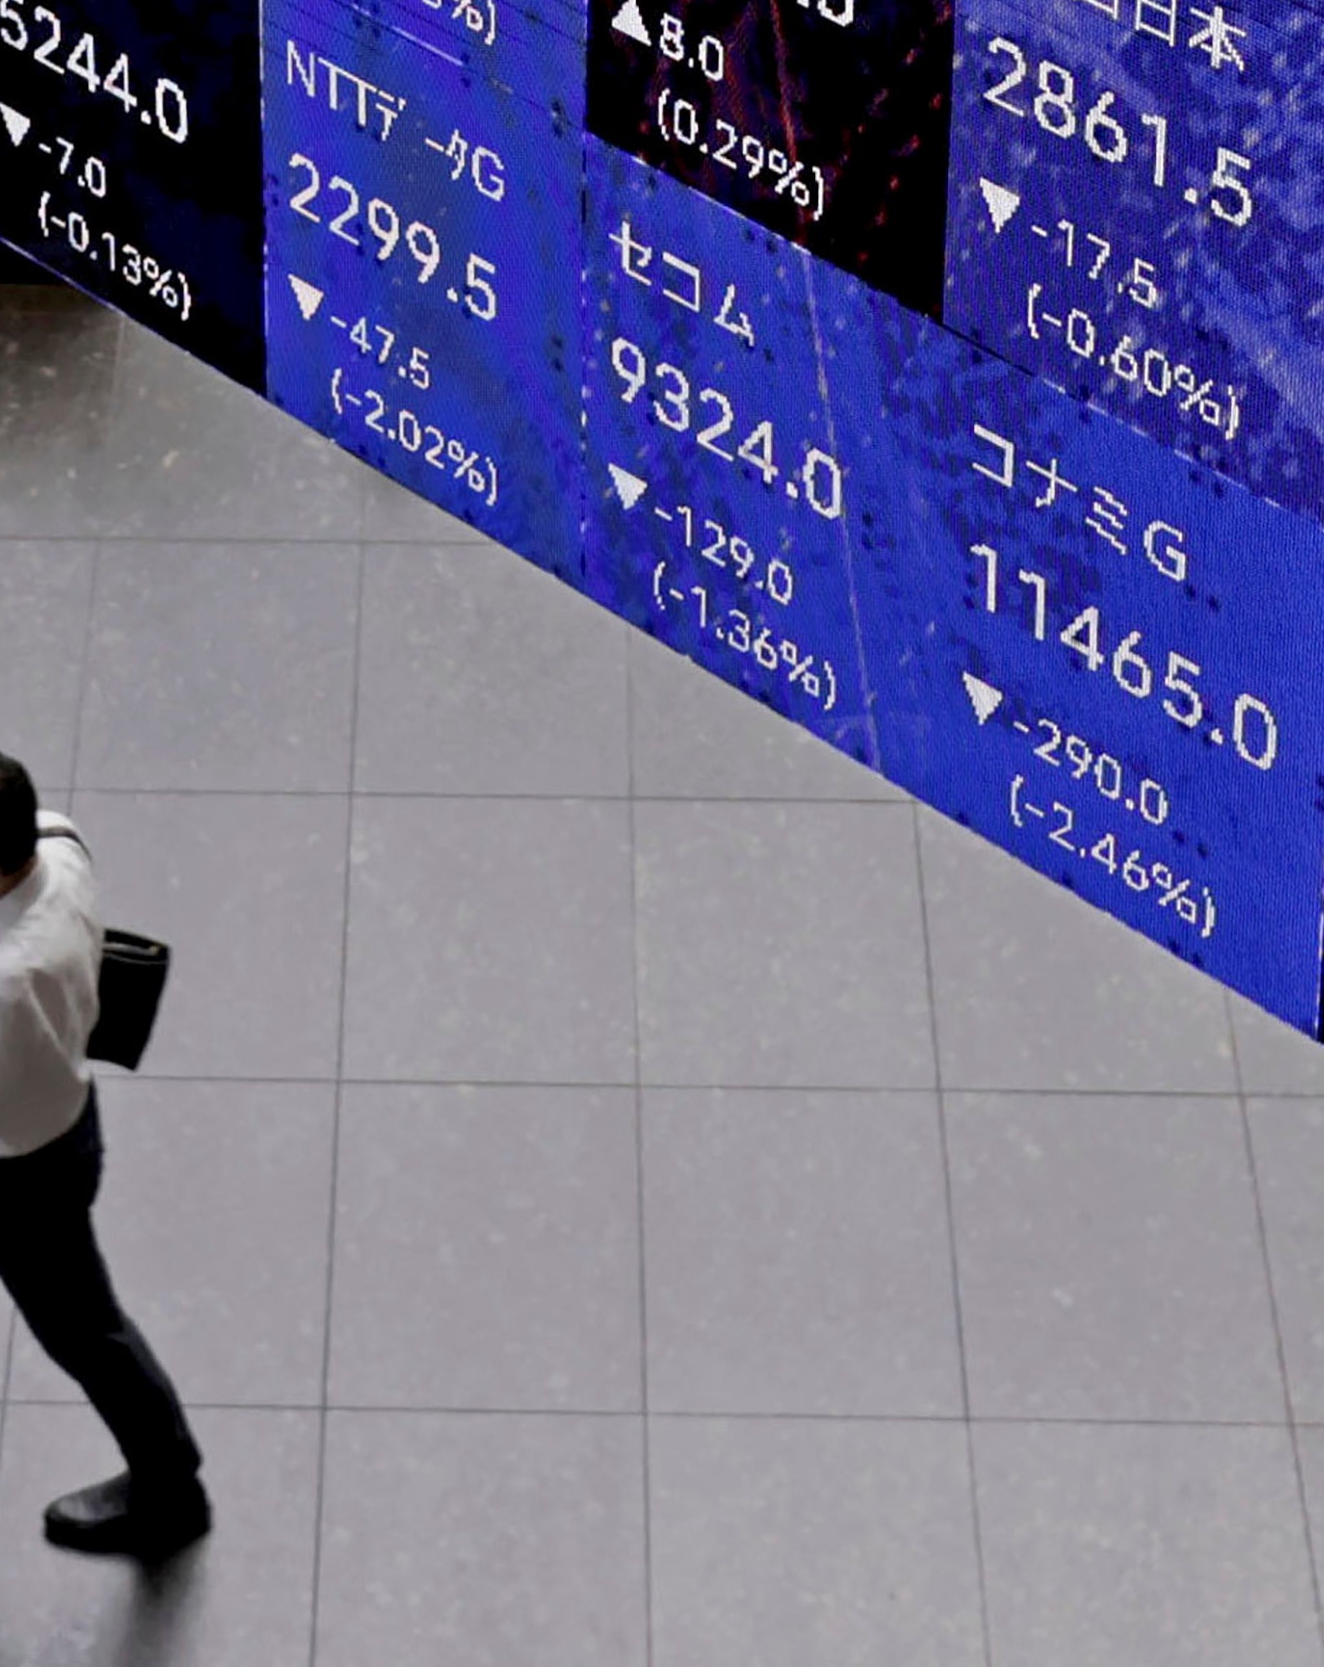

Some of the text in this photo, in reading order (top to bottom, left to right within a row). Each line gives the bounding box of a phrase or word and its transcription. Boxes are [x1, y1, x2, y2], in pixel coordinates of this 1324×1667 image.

[983, 36, 1253, 227] 2861.5
[288, 152, 497, 321] 2299.5
[610, 220, 754, 346] セコム
[331, 368, 497, 506] (-2.02%)
[1027, 283, 1240, 440] (-0.60%)
[973, 424, 1187, 582] コナミG
[971, 544, 1278, 771] 11465.0
[1015, 719, 1169, 825] -290.0
